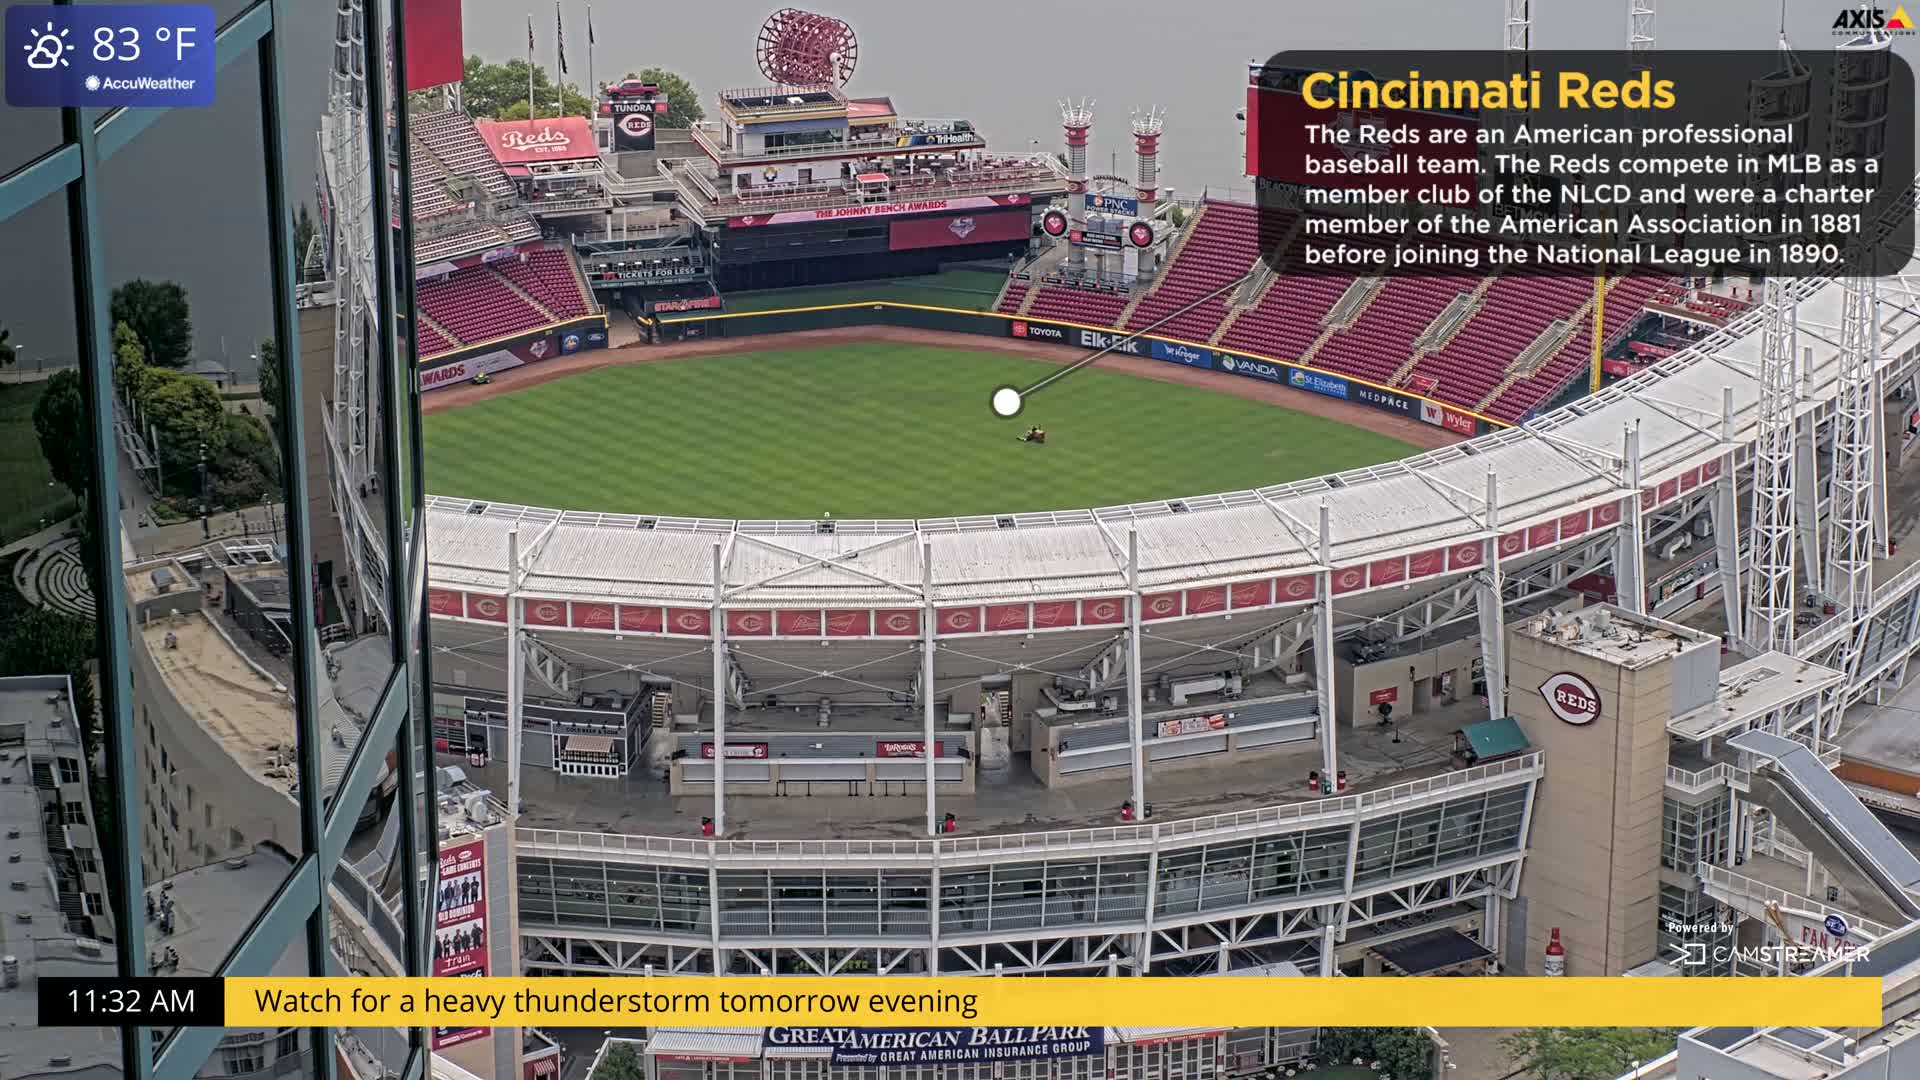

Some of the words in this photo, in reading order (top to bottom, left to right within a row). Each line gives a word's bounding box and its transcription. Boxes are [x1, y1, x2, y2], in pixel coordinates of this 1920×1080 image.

[615, 104, 652, 112] TUNDRA
[502, 127, 570, 150] Reds
[936, 133, 974, 144] TriHealth
[816, 209, 833, 218] THE
[835, 206, 872, 217] JOHNNY
[875, 203, 906, 214] BENCH
[907, 200, 948, 211] AWARDS
[1104, 198, 1129, 210] PNC
[618, 271, 653, 279] TICKETS
[1029, 327, 1062, 338] TOYOTA
[1235, 359, 1278, 376] VANDA
[1314, 377, 1346, 392] Elizabeth
[1360, 390, 1409, 410] MEDPACE
[1446, 412, 1473, 429] Wyler
[1555, 688, 1598, 714] REDS
[1802, 925, 1829, 951] FAN
[445, 953, 471, 968] train
[769, 1026, 848, 1044] GREAT
[840, 1031, 961, 1049] AMERICAN
[968, 1026, 1031, 1045] BALL
[1029, 1026, 1091, 1042] PARK
[835, 1053, 864, 1063] Presented
[864, 1054, 877, 1064] by
[880, 1050, 916, 1062] GREAT
[920, 1048, 979, 1060] AMERICAN
[984, 1044, 1048, 1059] INSURANCE
[1052, 1041, 1091, 1053] GROUP
